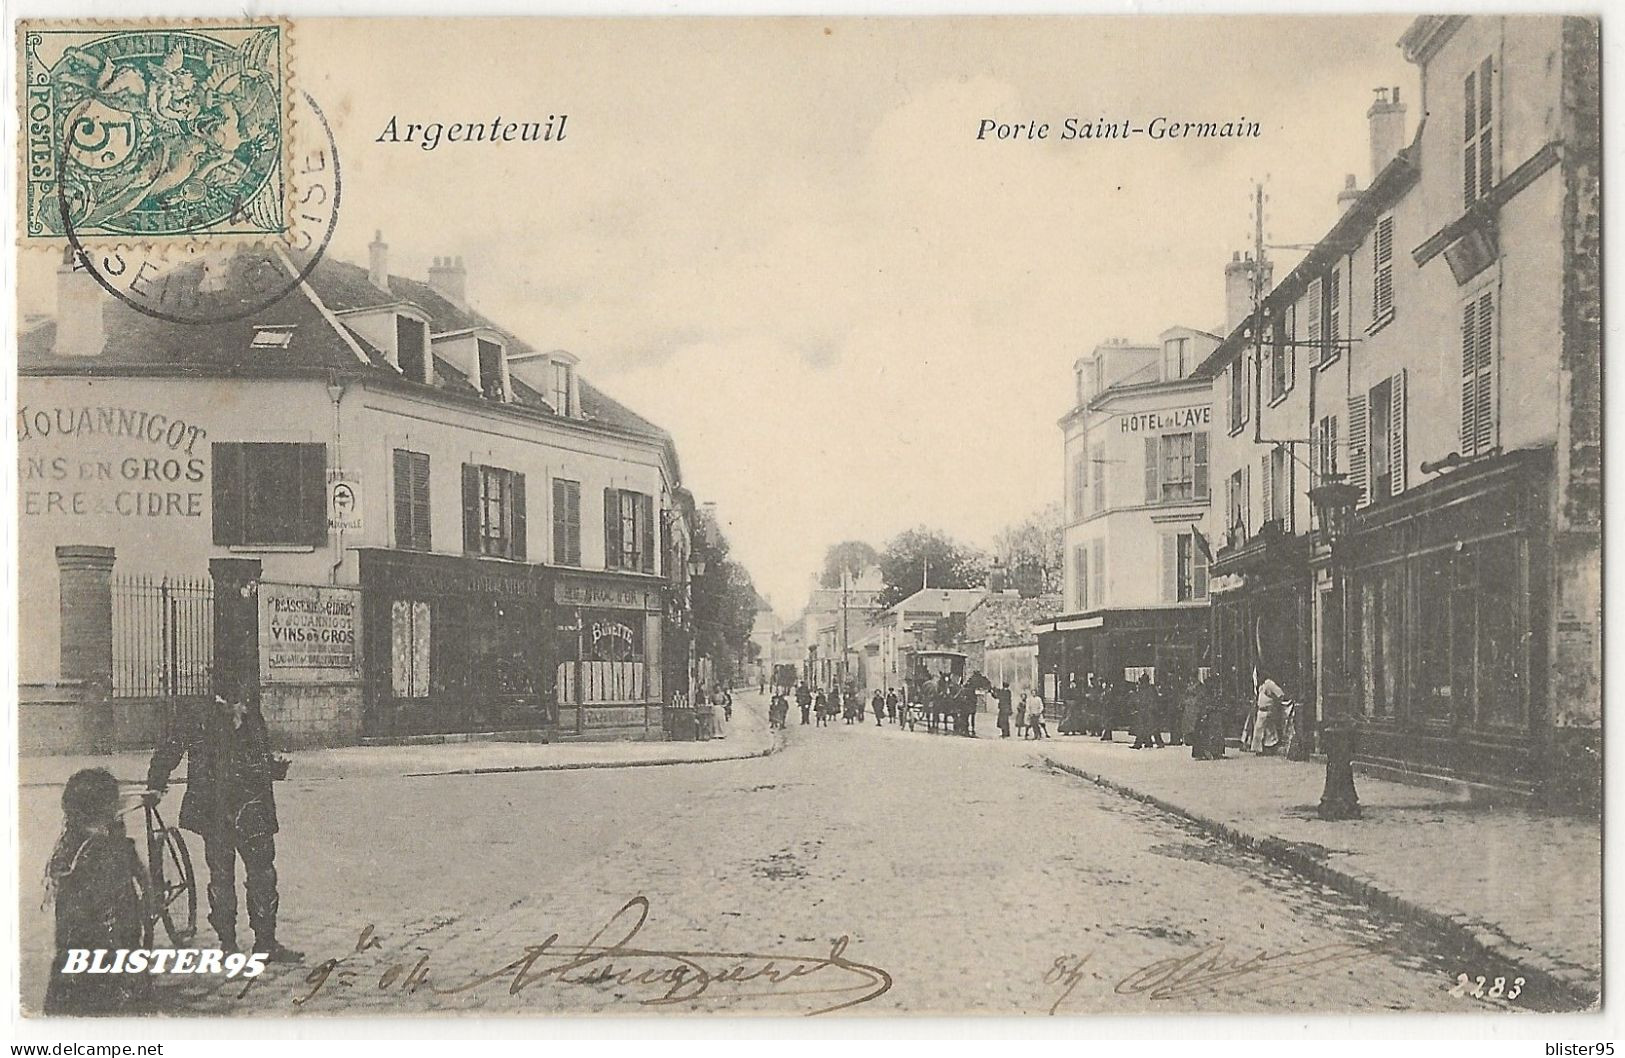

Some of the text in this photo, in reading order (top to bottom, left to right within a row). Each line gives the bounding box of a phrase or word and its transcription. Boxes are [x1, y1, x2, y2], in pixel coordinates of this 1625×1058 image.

[30, 88, 52, 178] POSTES
[375, 115, 569, 151] Argenteuil
[976, 116, 1261, 141] Porte Saint-Germain
[17, 406, 207, 455] JOUANNIGOT
[120, 457, 206, 483] GROS
[115, 491, 203, 517] CIDRE
[271, 627, 306, 642] VINS
[321, 629, 356, 644] GROS
[1448, 972, 1527, 1000] 2283
